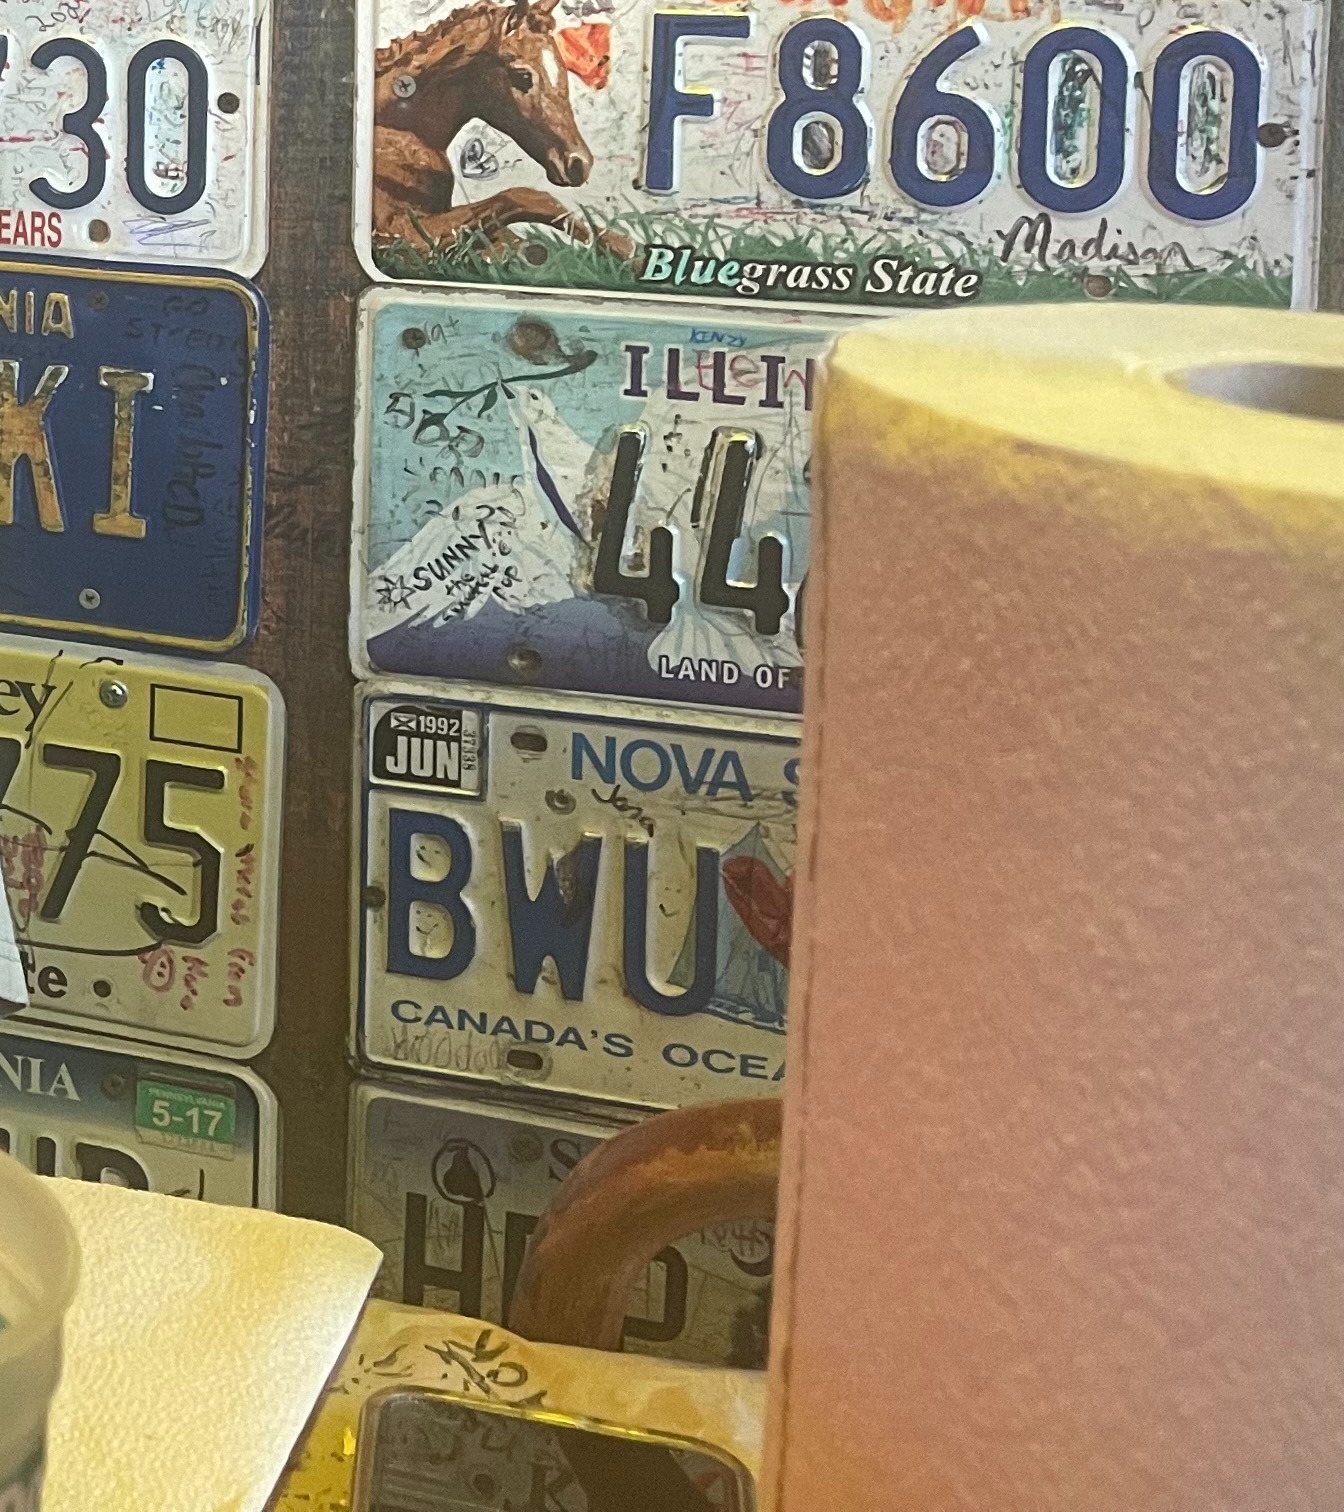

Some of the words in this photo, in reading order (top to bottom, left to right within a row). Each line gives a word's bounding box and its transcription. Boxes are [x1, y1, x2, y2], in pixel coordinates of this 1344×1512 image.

[643, 10, 1266, 221] F8600
[997, 212, 1196, 270] Madison
[640, 244, 855, 295] Bluegrass
[865, 257, 981, 300] State
[411, 519, 498, 592] SUNNY
[658, 655, 740, 685] LAND
[754, 664, 790, 689] OF
[417, 714, 460, 737] 1992
[385, 735, 460, 781] JUN
[570, 731, 757, 802] NOVA
[387, 808, 721, 1016] BWU
[390, 999, 635, 1058] CANADA'S
[151, 1097, 223, 1137] 5-17
